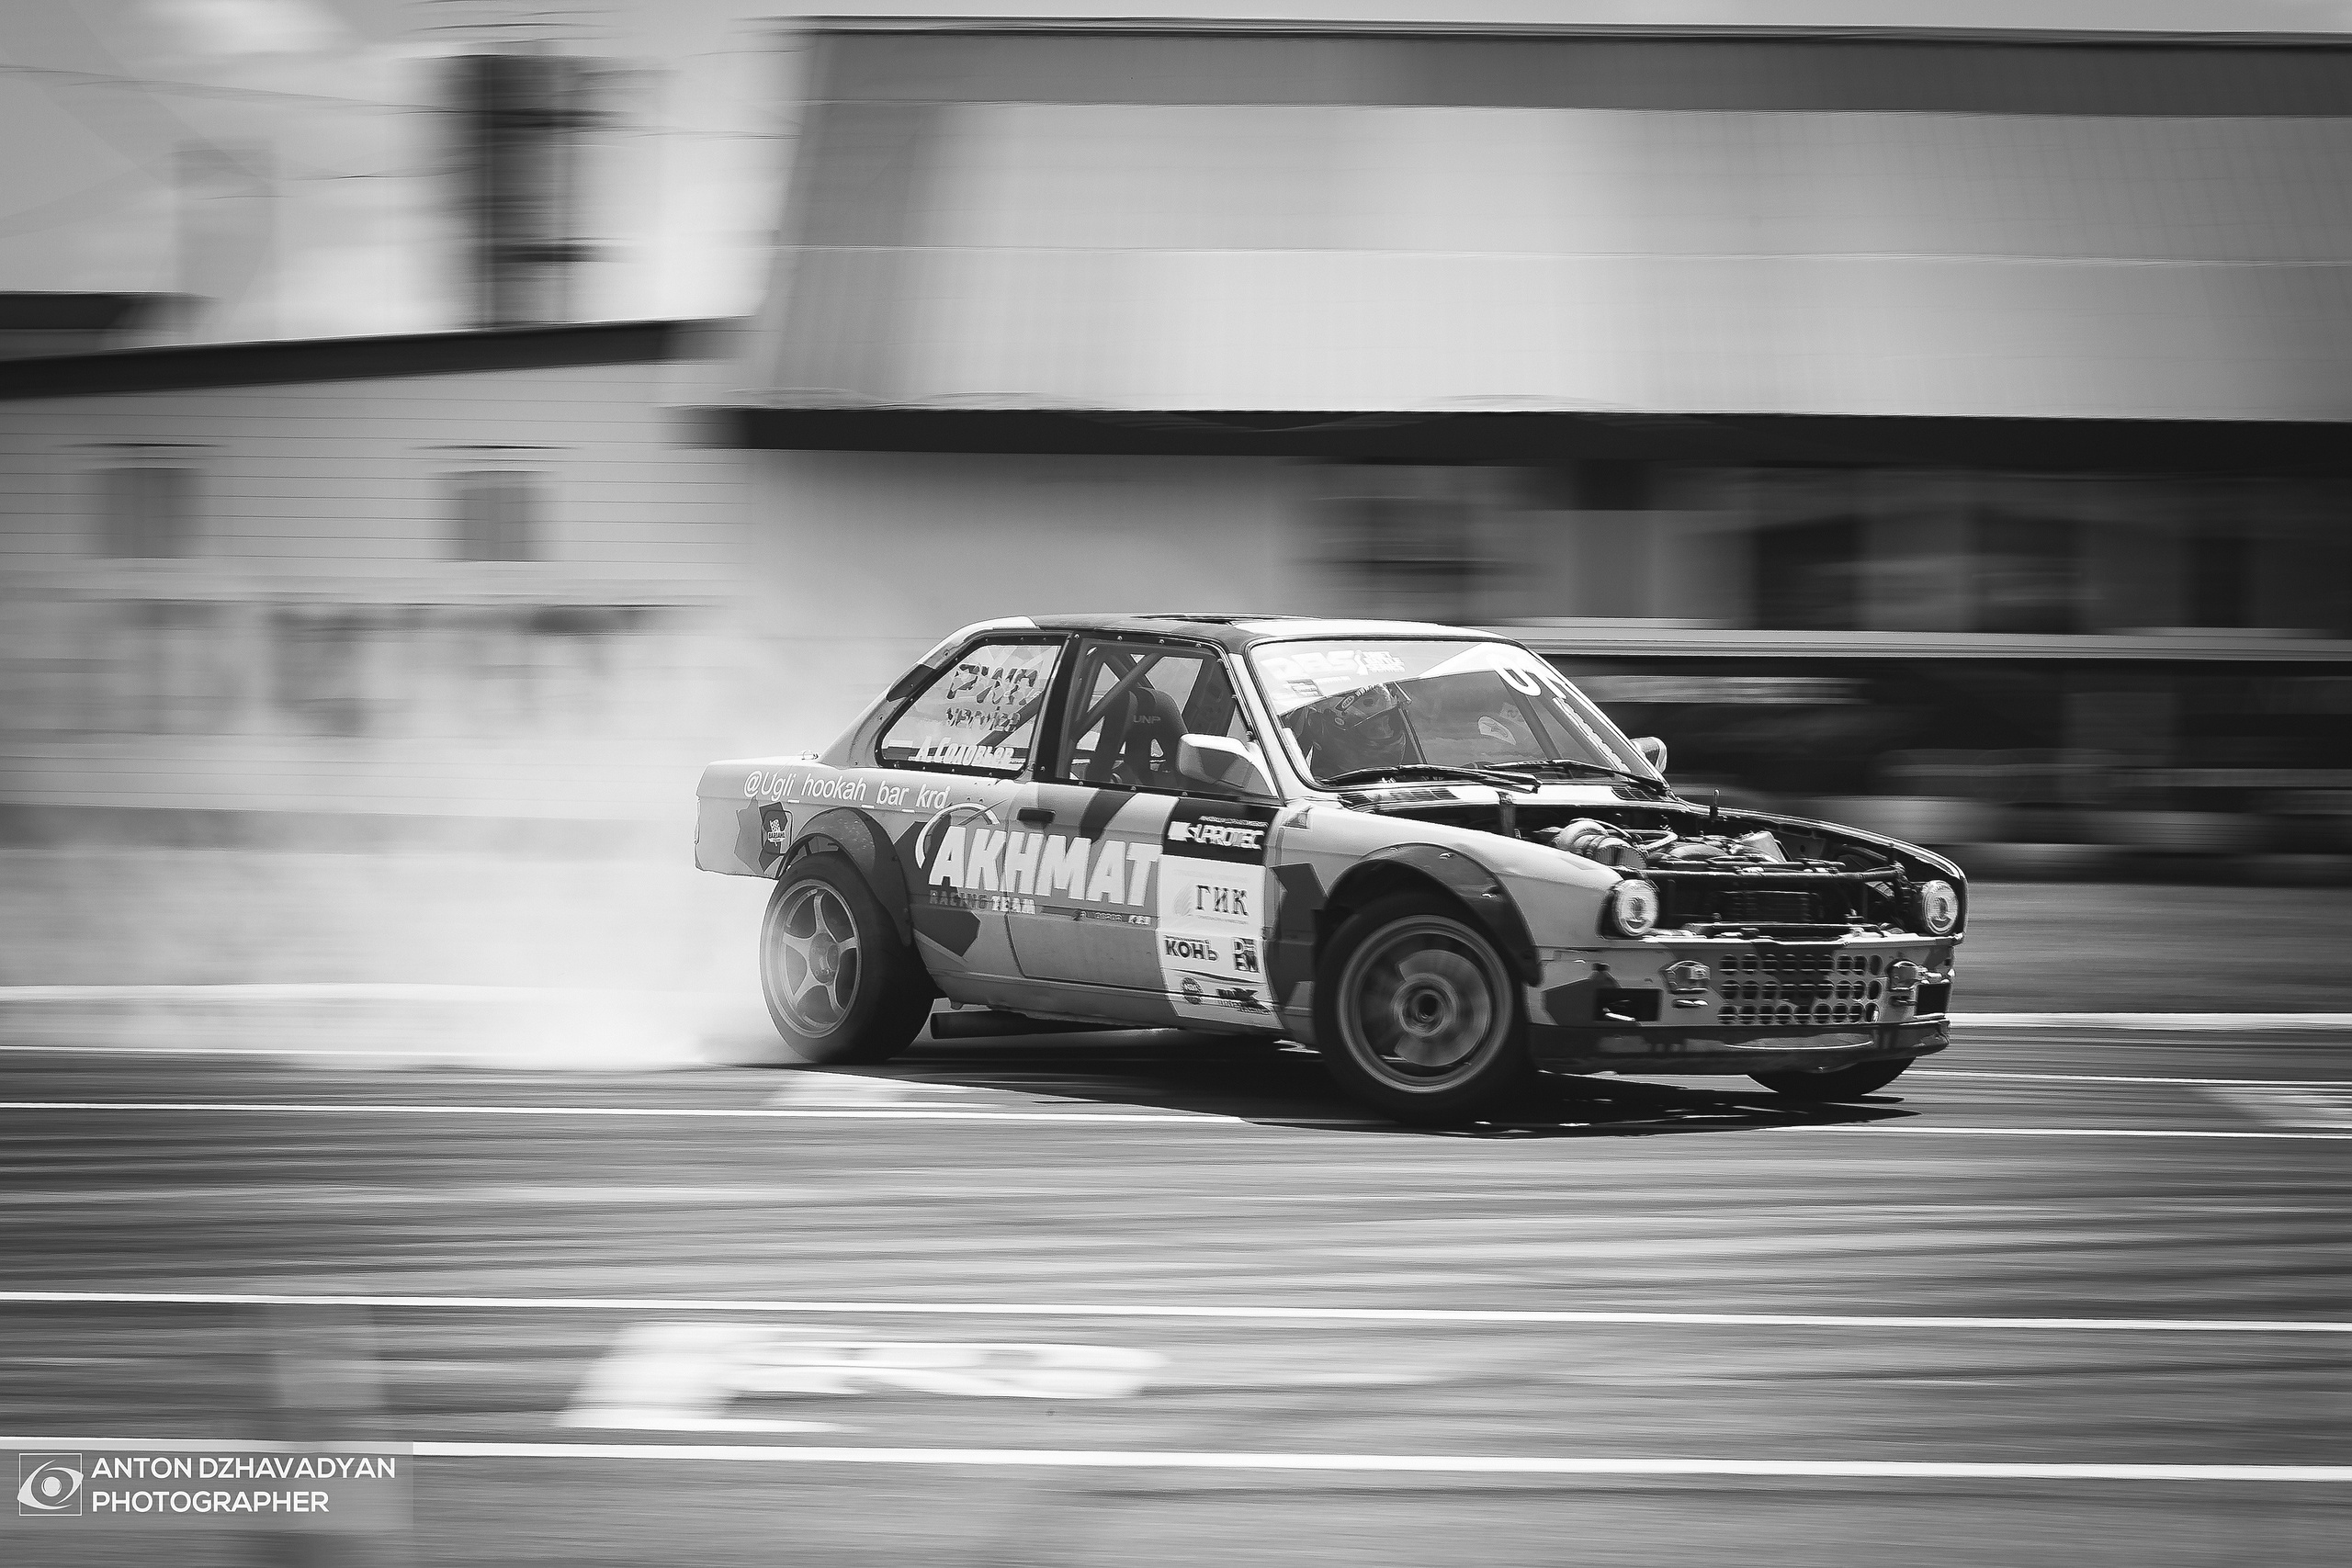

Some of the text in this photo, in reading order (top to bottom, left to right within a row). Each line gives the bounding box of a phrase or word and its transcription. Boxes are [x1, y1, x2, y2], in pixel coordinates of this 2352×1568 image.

[928, 825, 1164, 907] AKHMAT
[930, 889, 1036, 916] RACING TEAM
[1195, 884, 1250, 917] ГИК
[1164, 939, 1219, 963] КОНЬ
